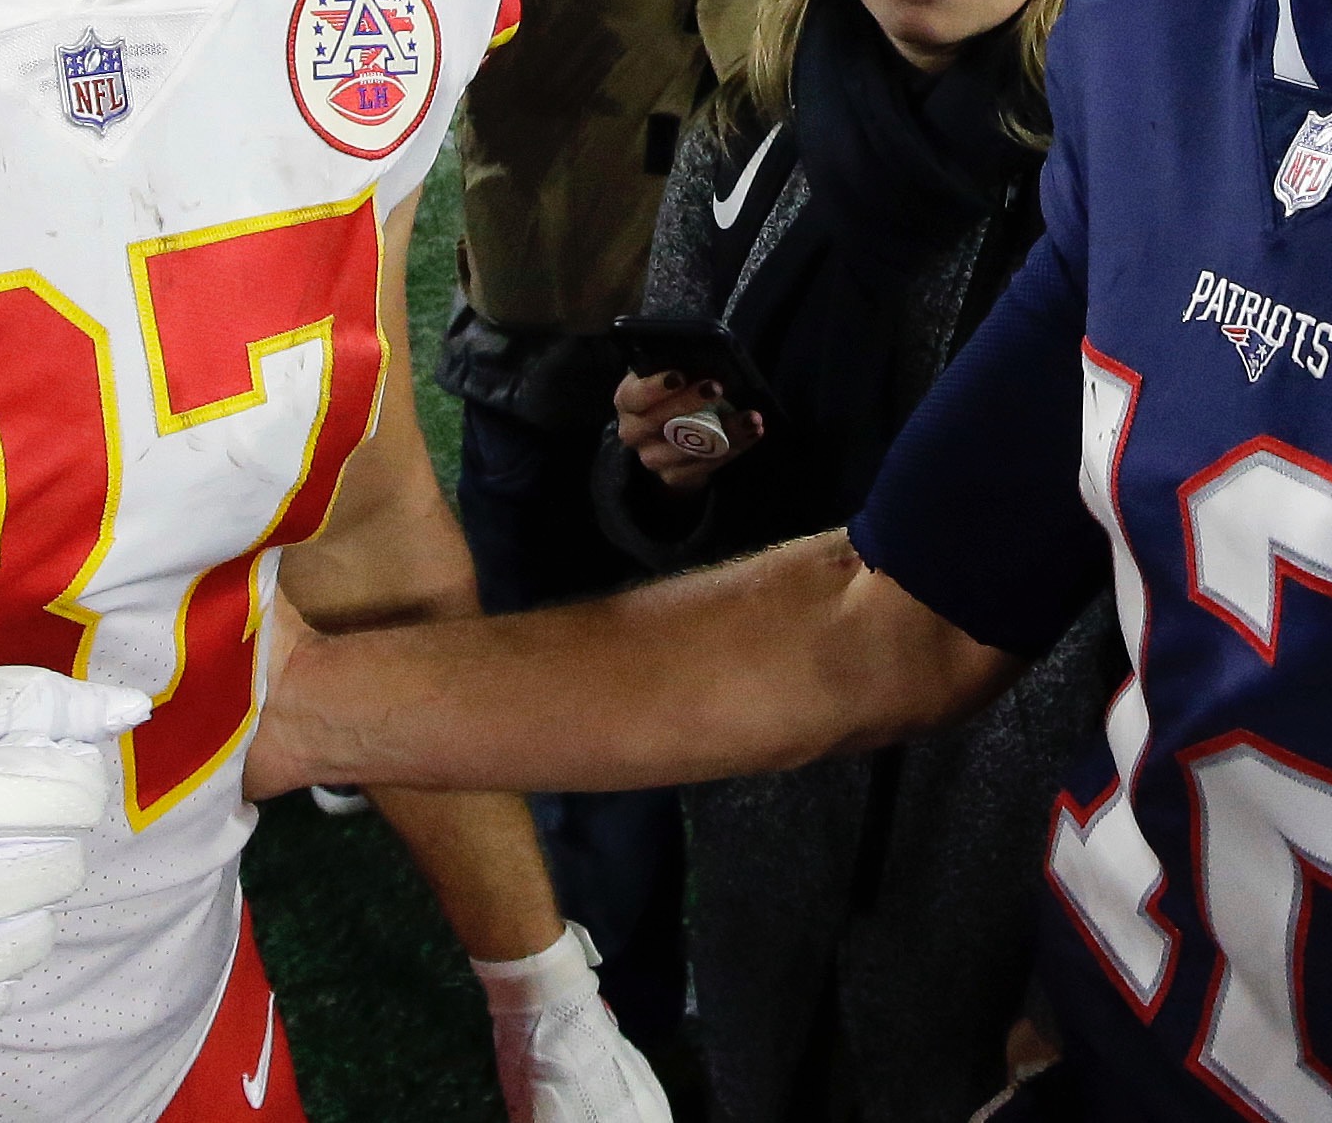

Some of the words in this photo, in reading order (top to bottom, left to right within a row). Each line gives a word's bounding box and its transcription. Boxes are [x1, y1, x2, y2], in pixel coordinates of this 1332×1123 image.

[72, 77, 124, 117] NFL
[358, 85, 389, 111] LH
[1283, 150, 1328, 195] NFL
